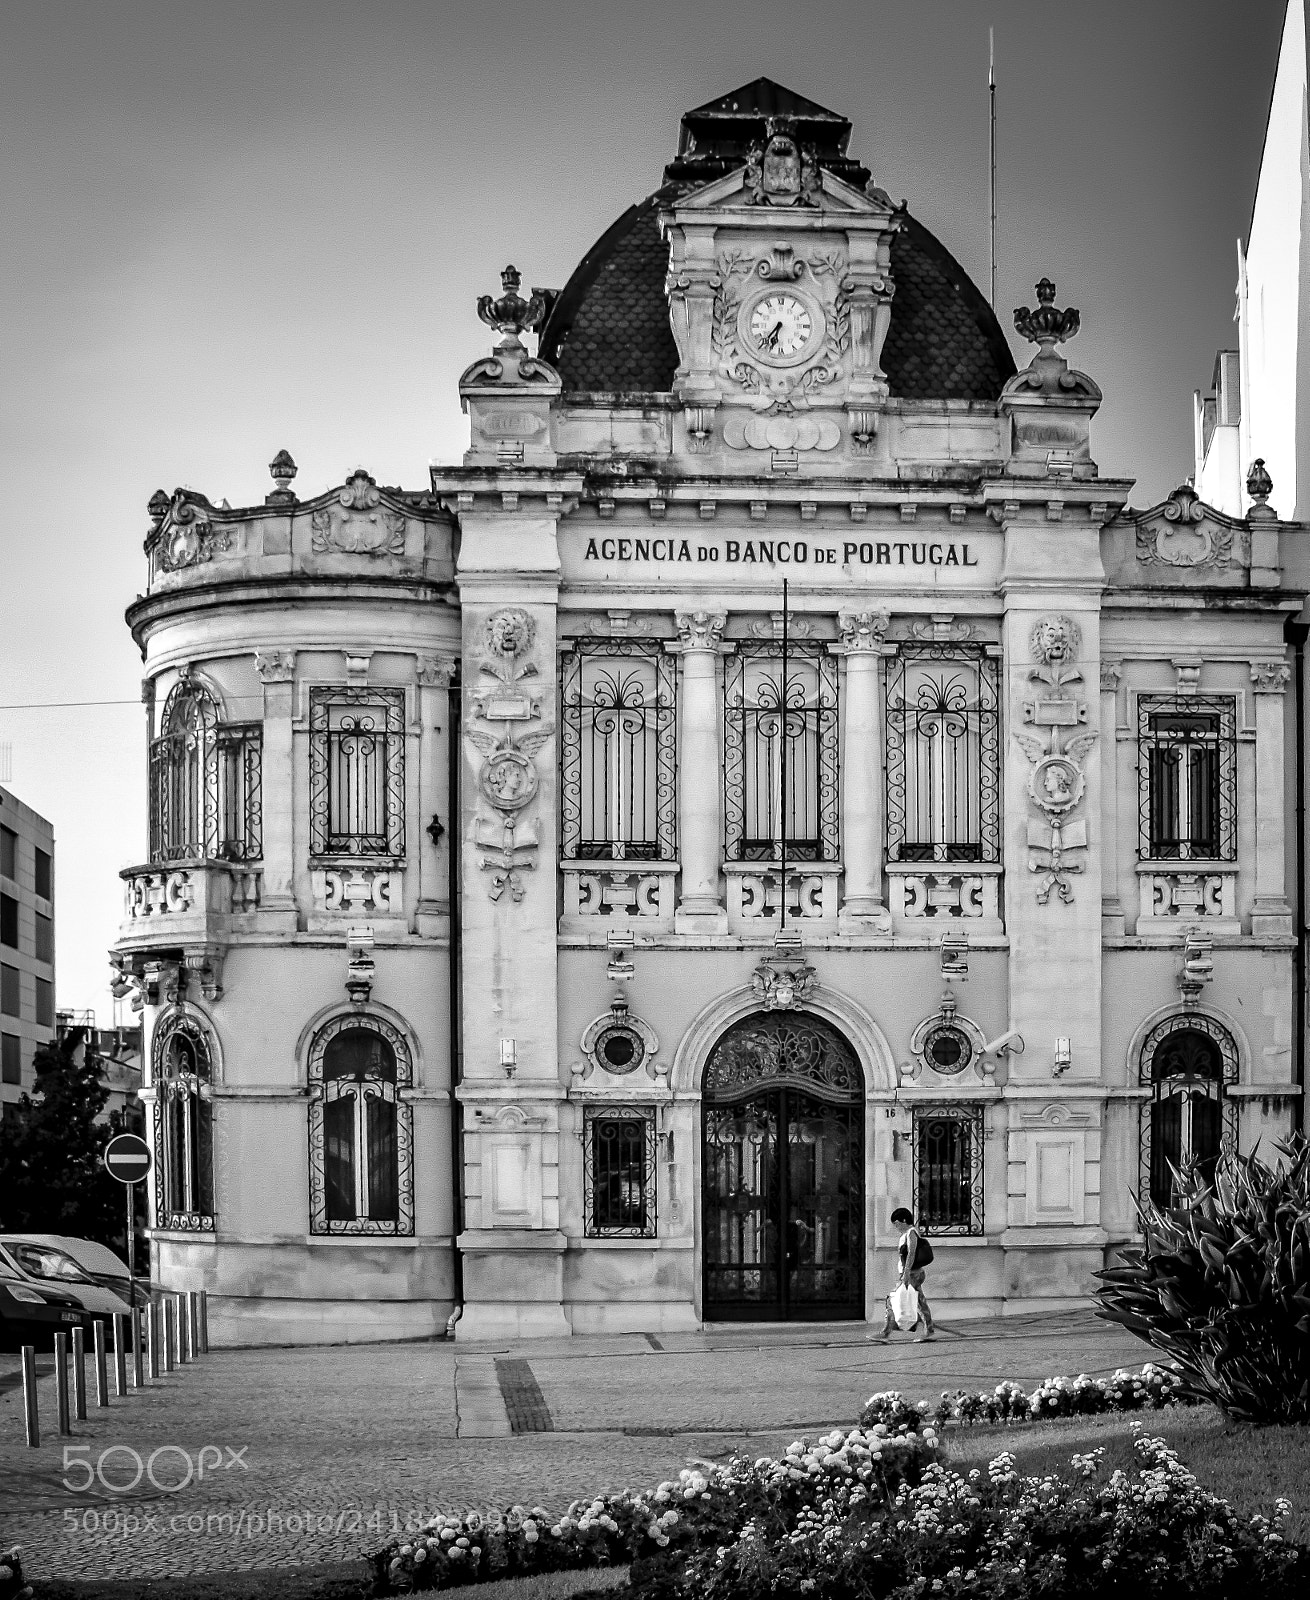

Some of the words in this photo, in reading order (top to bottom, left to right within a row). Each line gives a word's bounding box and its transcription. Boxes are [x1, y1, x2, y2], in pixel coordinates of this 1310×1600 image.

[584, 538, 692, 562] AGENCIA
[697, 546, 719, 562] DO
[726, 541, 807, 564] BANCO
[814, 548, 837, 564] DE
[842, 542, 978, 567] PORTUGAL
[885, 1108, 896, 1119] 16
